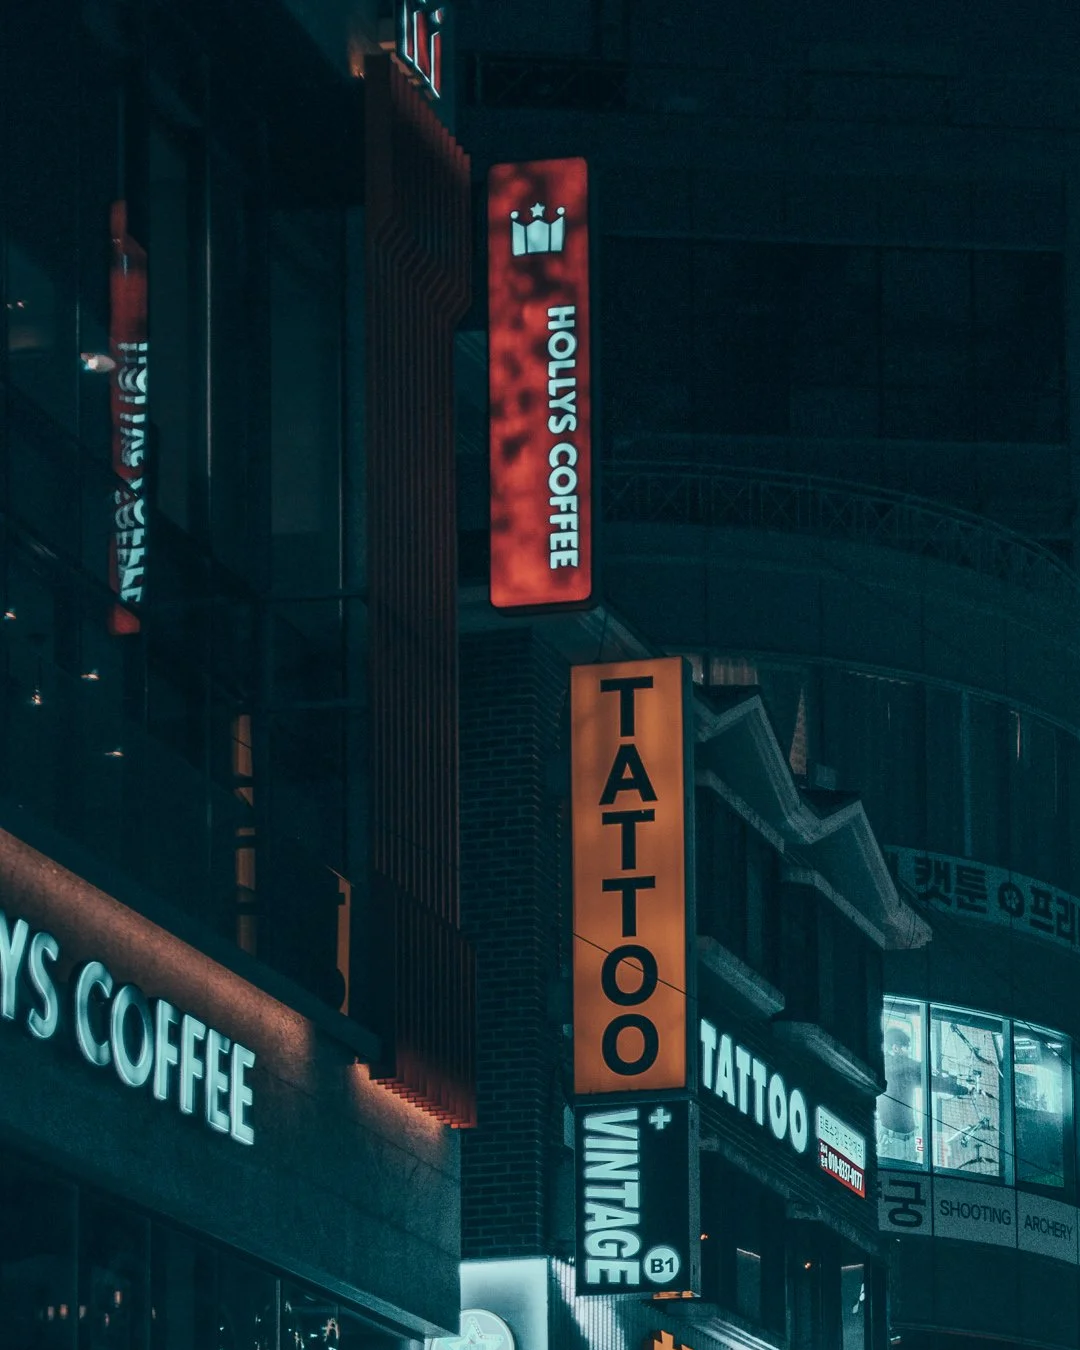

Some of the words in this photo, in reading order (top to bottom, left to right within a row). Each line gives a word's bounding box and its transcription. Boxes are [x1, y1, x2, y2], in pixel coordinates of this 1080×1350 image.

[547, 305, 577, 434] HOLLYS
[547, 442, 578, 569] COFFEE
[598, 676, 659, 1076] TATTOO
[77, 961, 255, 1145] COFFEE
[701, 1018, 808, 1153] TATTOO
[584, 1108, 641, 1285] VINTAGE
[940, 1200, 1012, 1226] SHOOTING
[1024, 1214, 1074, 1241] ARCHERY
[649, 1256, 675, 1275] B1
